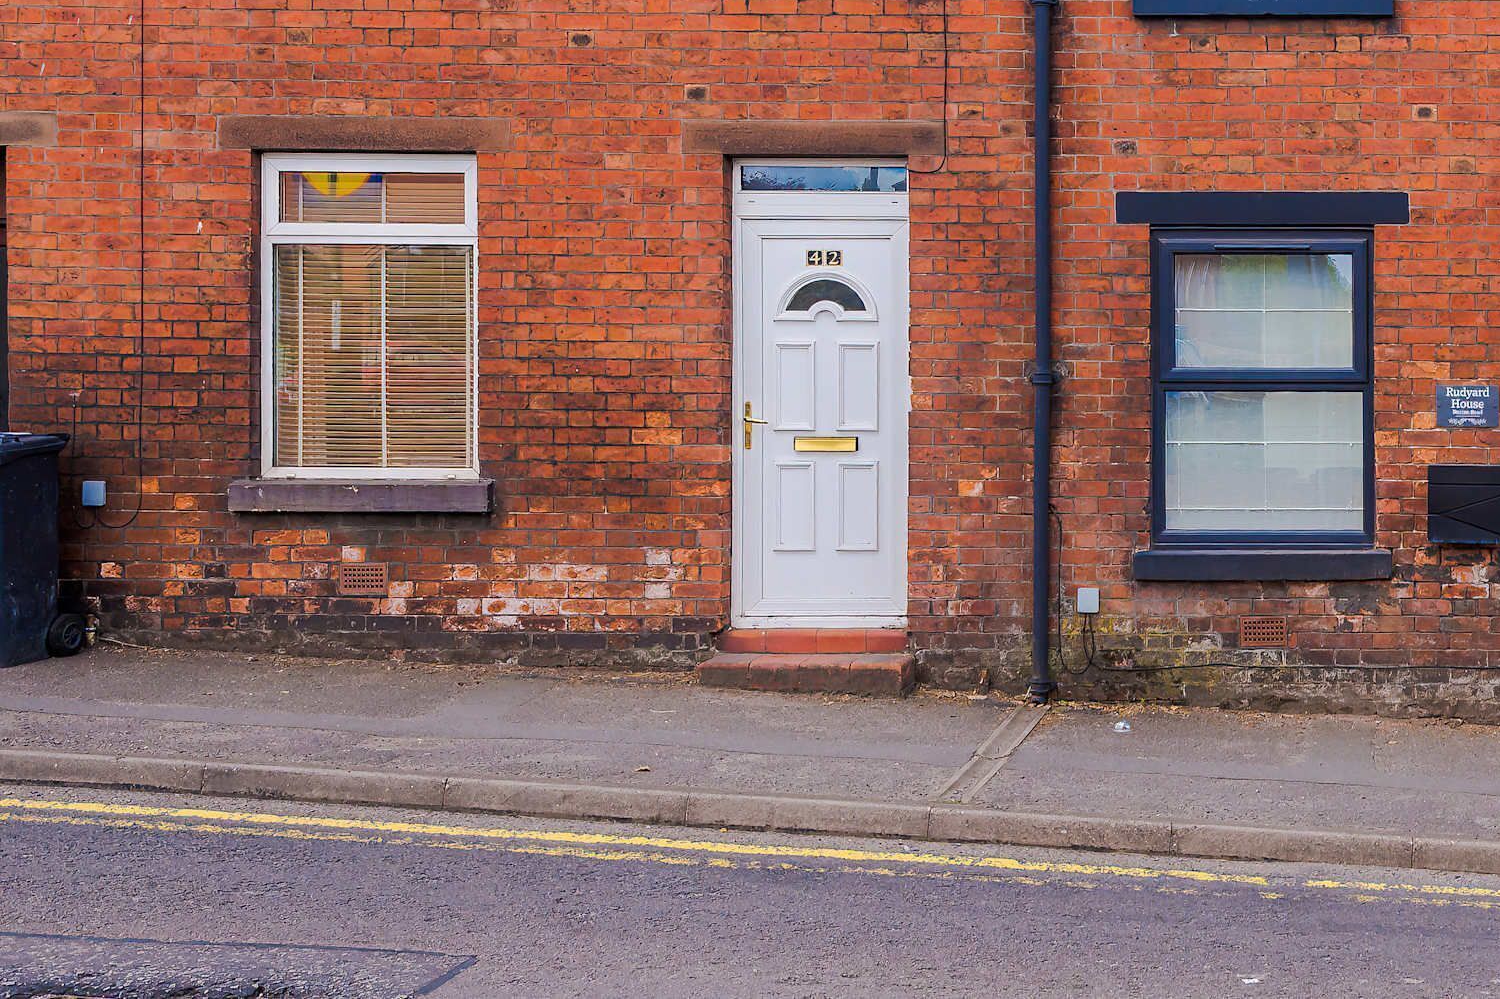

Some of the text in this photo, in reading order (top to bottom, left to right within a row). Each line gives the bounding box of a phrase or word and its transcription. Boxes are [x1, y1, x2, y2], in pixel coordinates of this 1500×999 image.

[808, 251, 840, 265] 42
[1445, 387, 1490, 399] Rudyard
[1450, 399, 1485, 409] House
